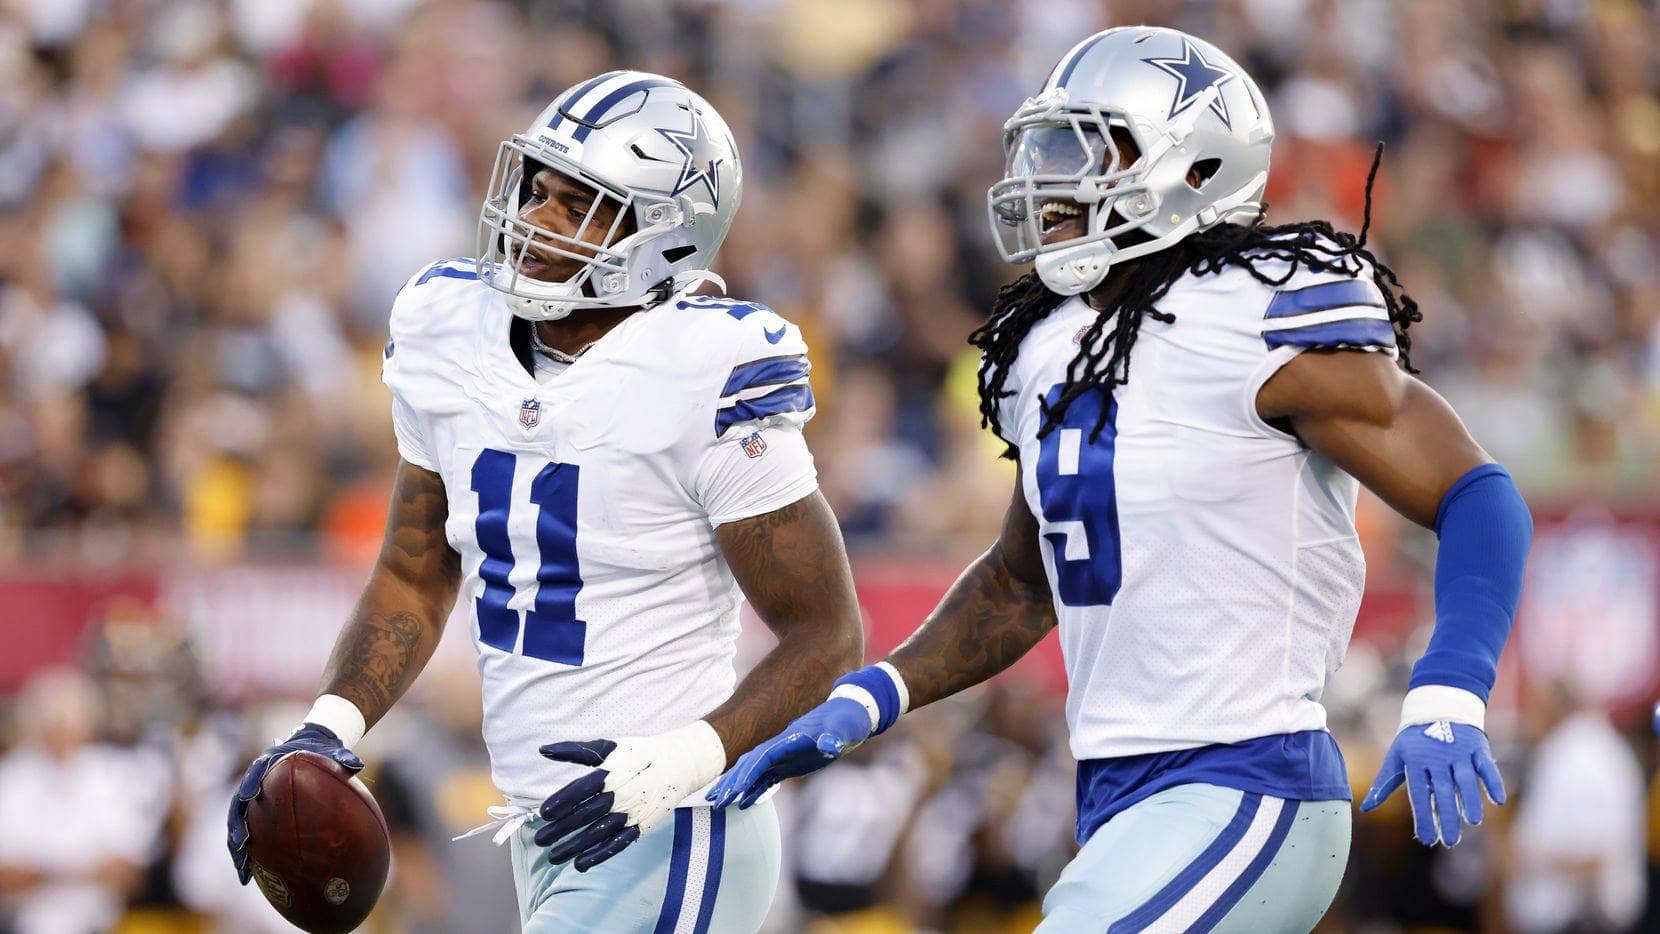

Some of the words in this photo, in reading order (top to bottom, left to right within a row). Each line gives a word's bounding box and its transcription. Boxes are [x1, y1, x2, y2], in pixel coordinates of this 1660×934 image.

[538, 134, 570, 154] COWBOYS
[470, 448, 587, 666] 11
[1036, 382, 1123, 606] 9
